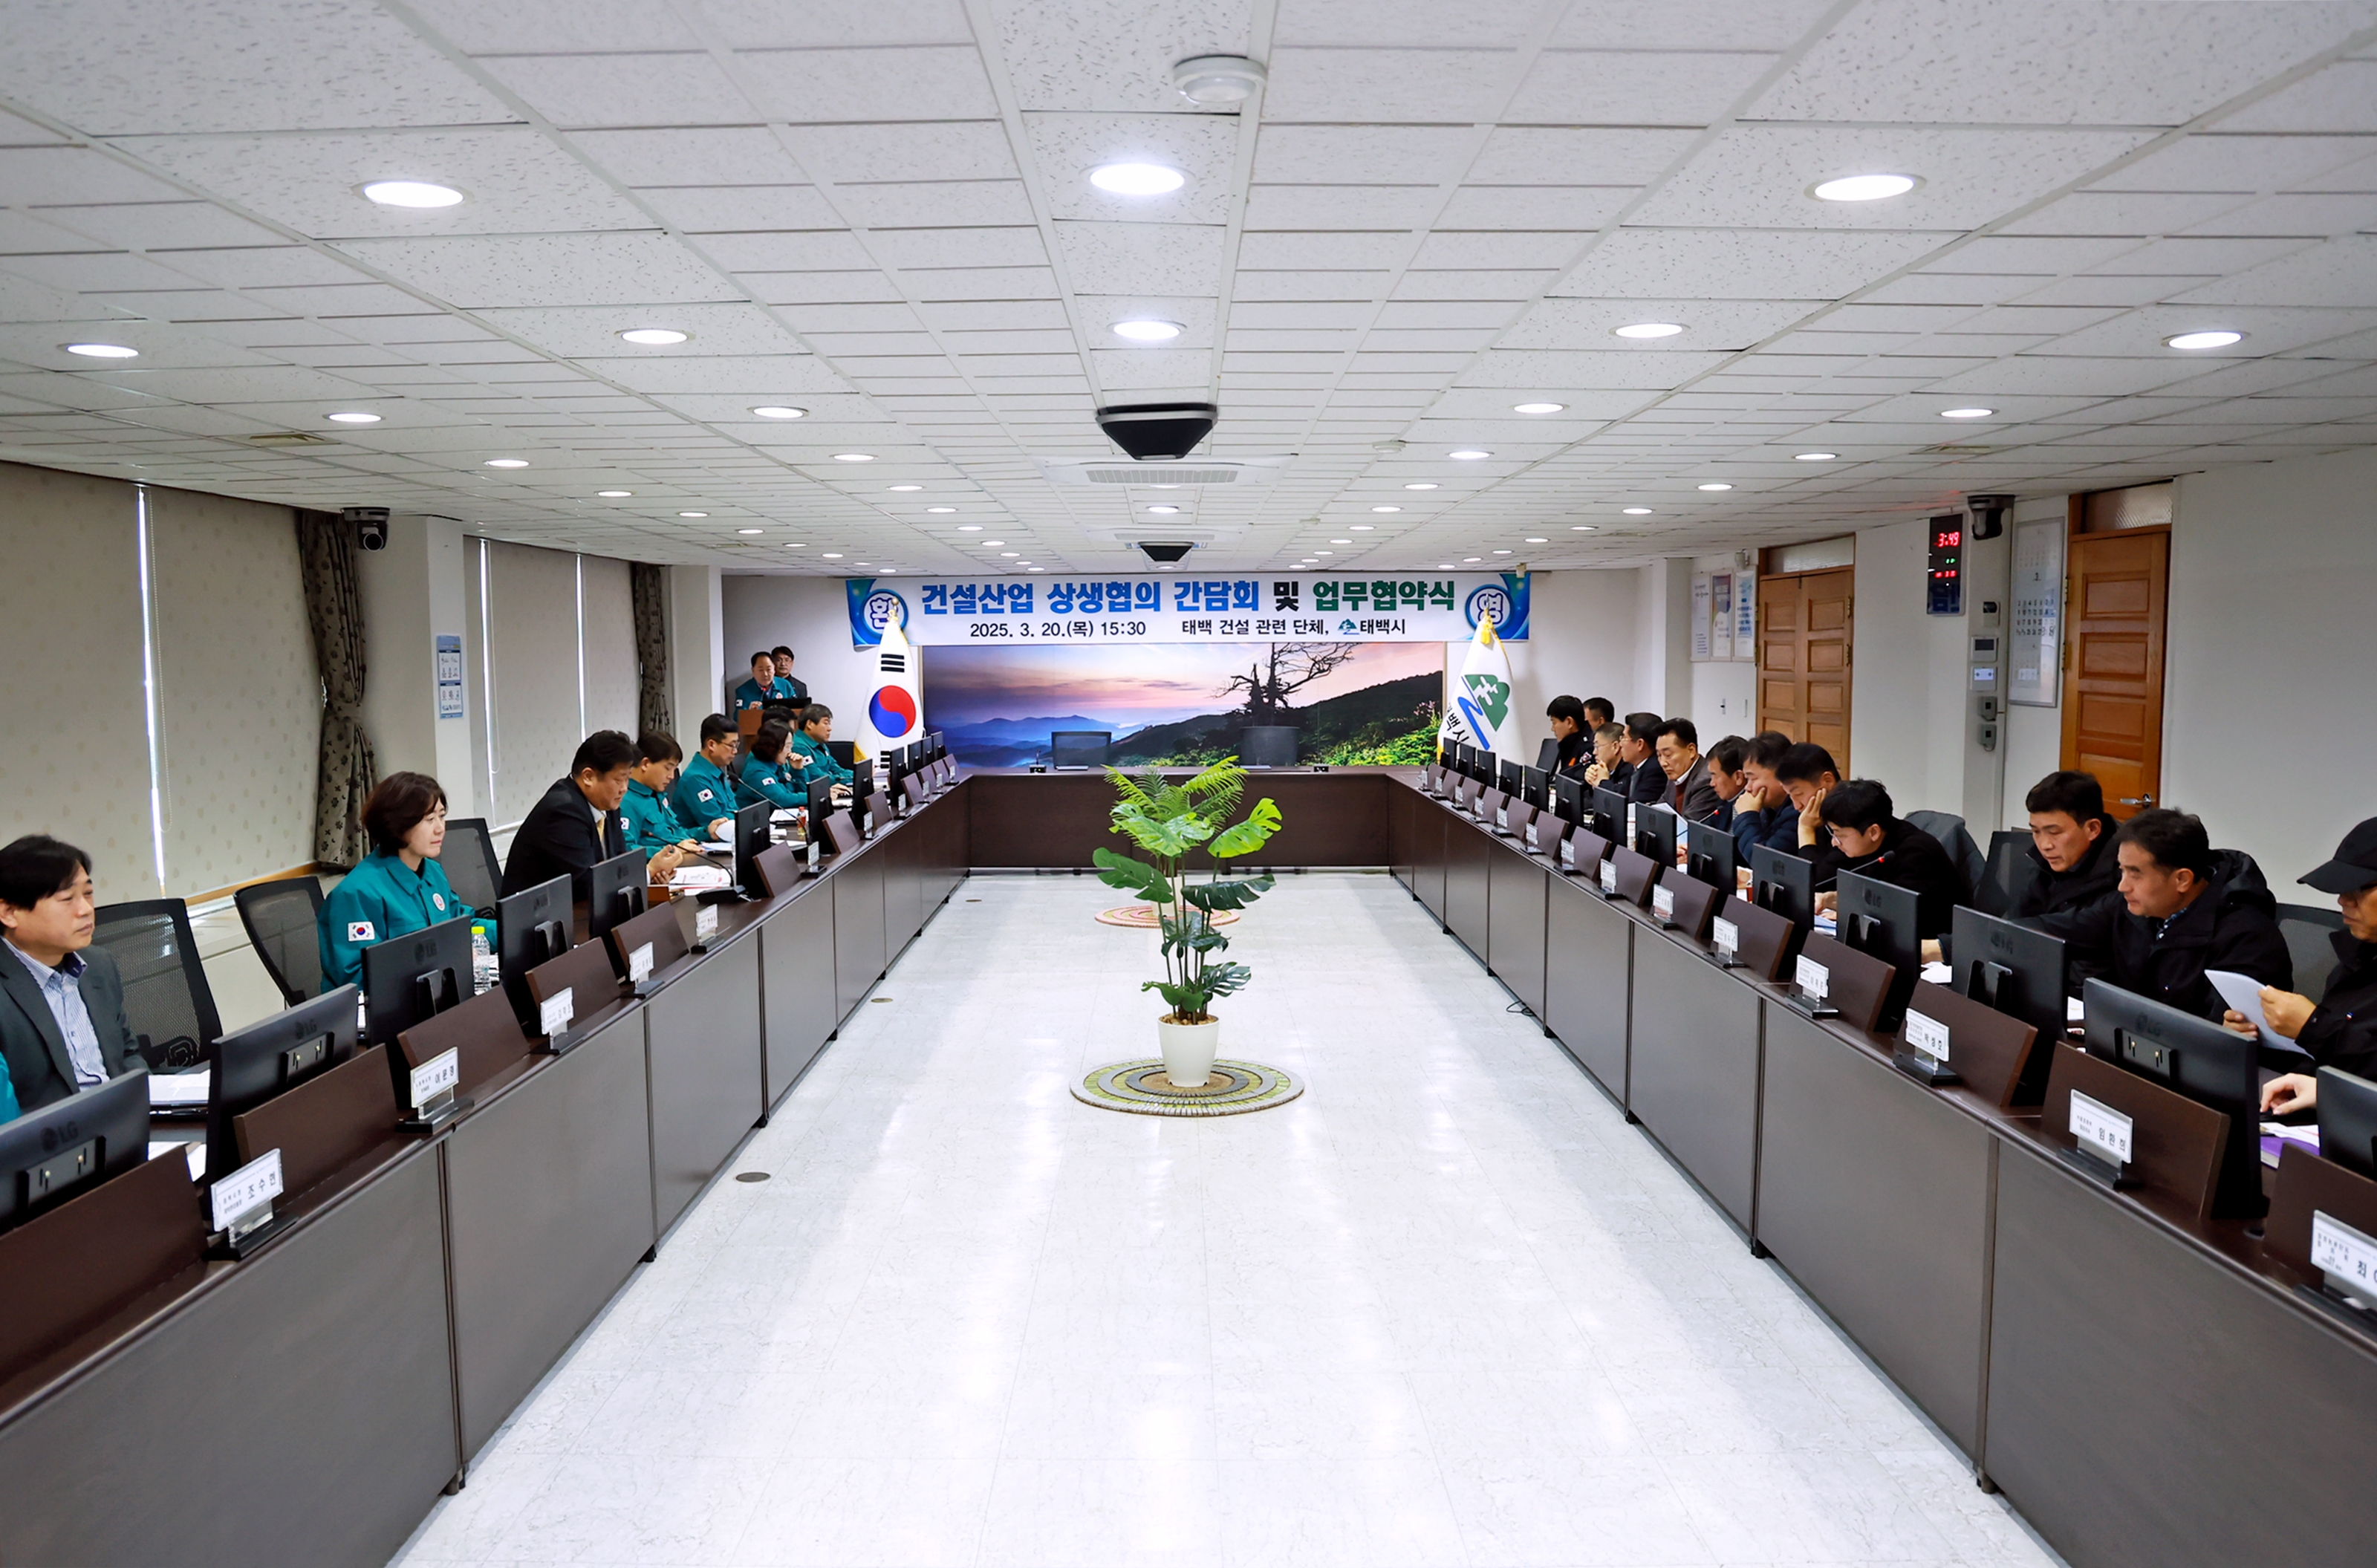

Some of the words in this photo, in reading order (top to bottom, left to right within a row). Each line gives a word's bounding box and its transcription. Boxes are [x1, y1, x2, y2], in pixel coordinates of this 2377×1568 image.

[1937, 532, 1960, 547] 3:49
[921, 582, 1034, 615] 건설산업
[1047, 581, 1161, 614] 상생협의
[1174, 580, 1260, 612] 간담회
[1273, 581, 1299, 612] 및
[1313, 580, 1455, 612] 업무협약식
[1477, 593, 1503, 625] 영
[970, 622, 1014, 637] 2025.
[1020, 622, 1035, 637] 3.
[1041, 620, 1094, 637] 20.(목)
[1101, 621, 1146, 636] 15:30
[1182, 619, 1212, 635] 태백
[1220, 619, 1249, 635] 건설
[1255, 619, 1286, 635] 관련
[1293, 619, 1329, 636] 단체,
[1360, 619, 1405, 635] 태백시
[58, 1121, 79, 1143] LG
